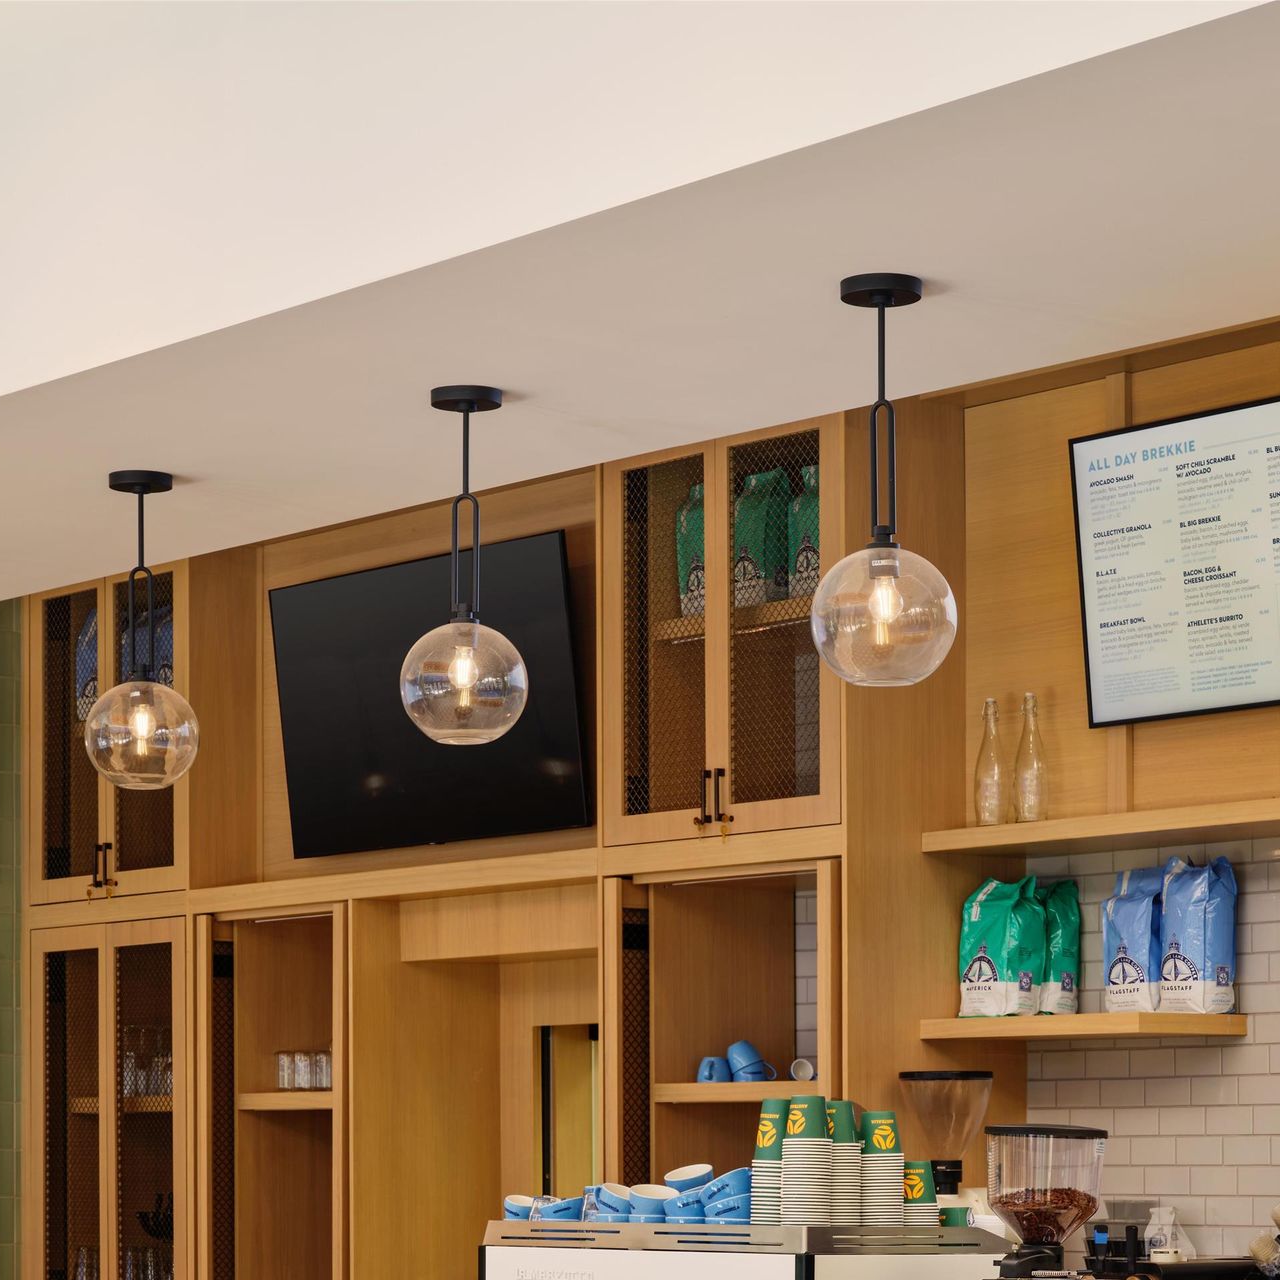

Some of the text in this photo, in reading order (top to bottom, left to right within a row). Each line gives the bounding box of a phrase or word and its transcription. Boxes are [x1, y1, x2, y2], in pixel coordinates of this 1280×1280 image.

[1266, 446, 1274, 454] BL
[1088, 440, 1196, 472] ALL DAY BREKKIE
[1176, 463, 1190, 471] SOFT
[1205, 454, 1236, 466] SCRAMBLE
[1185, 466, 1211, 477] AVOCADO
[1115, 473, 1134, 483] SMASH
[1197, 515, 1222, 526] BREKKIE
[1093, 523, 1152, 539] COLLECTIVE GRANOLA
[1204, 566, 1216, 574] EGG
[1183, 571, 1237, 585] CHEESE CROISSANT
[1218, 613, 1244, 623] BURRITO
[1099, 619, 1129, 629] BREAKFAST
[1109, 987, 1140, 997] FLAGSTAFF
[1161, 985, 1192, 994] FLAGSTAFF
